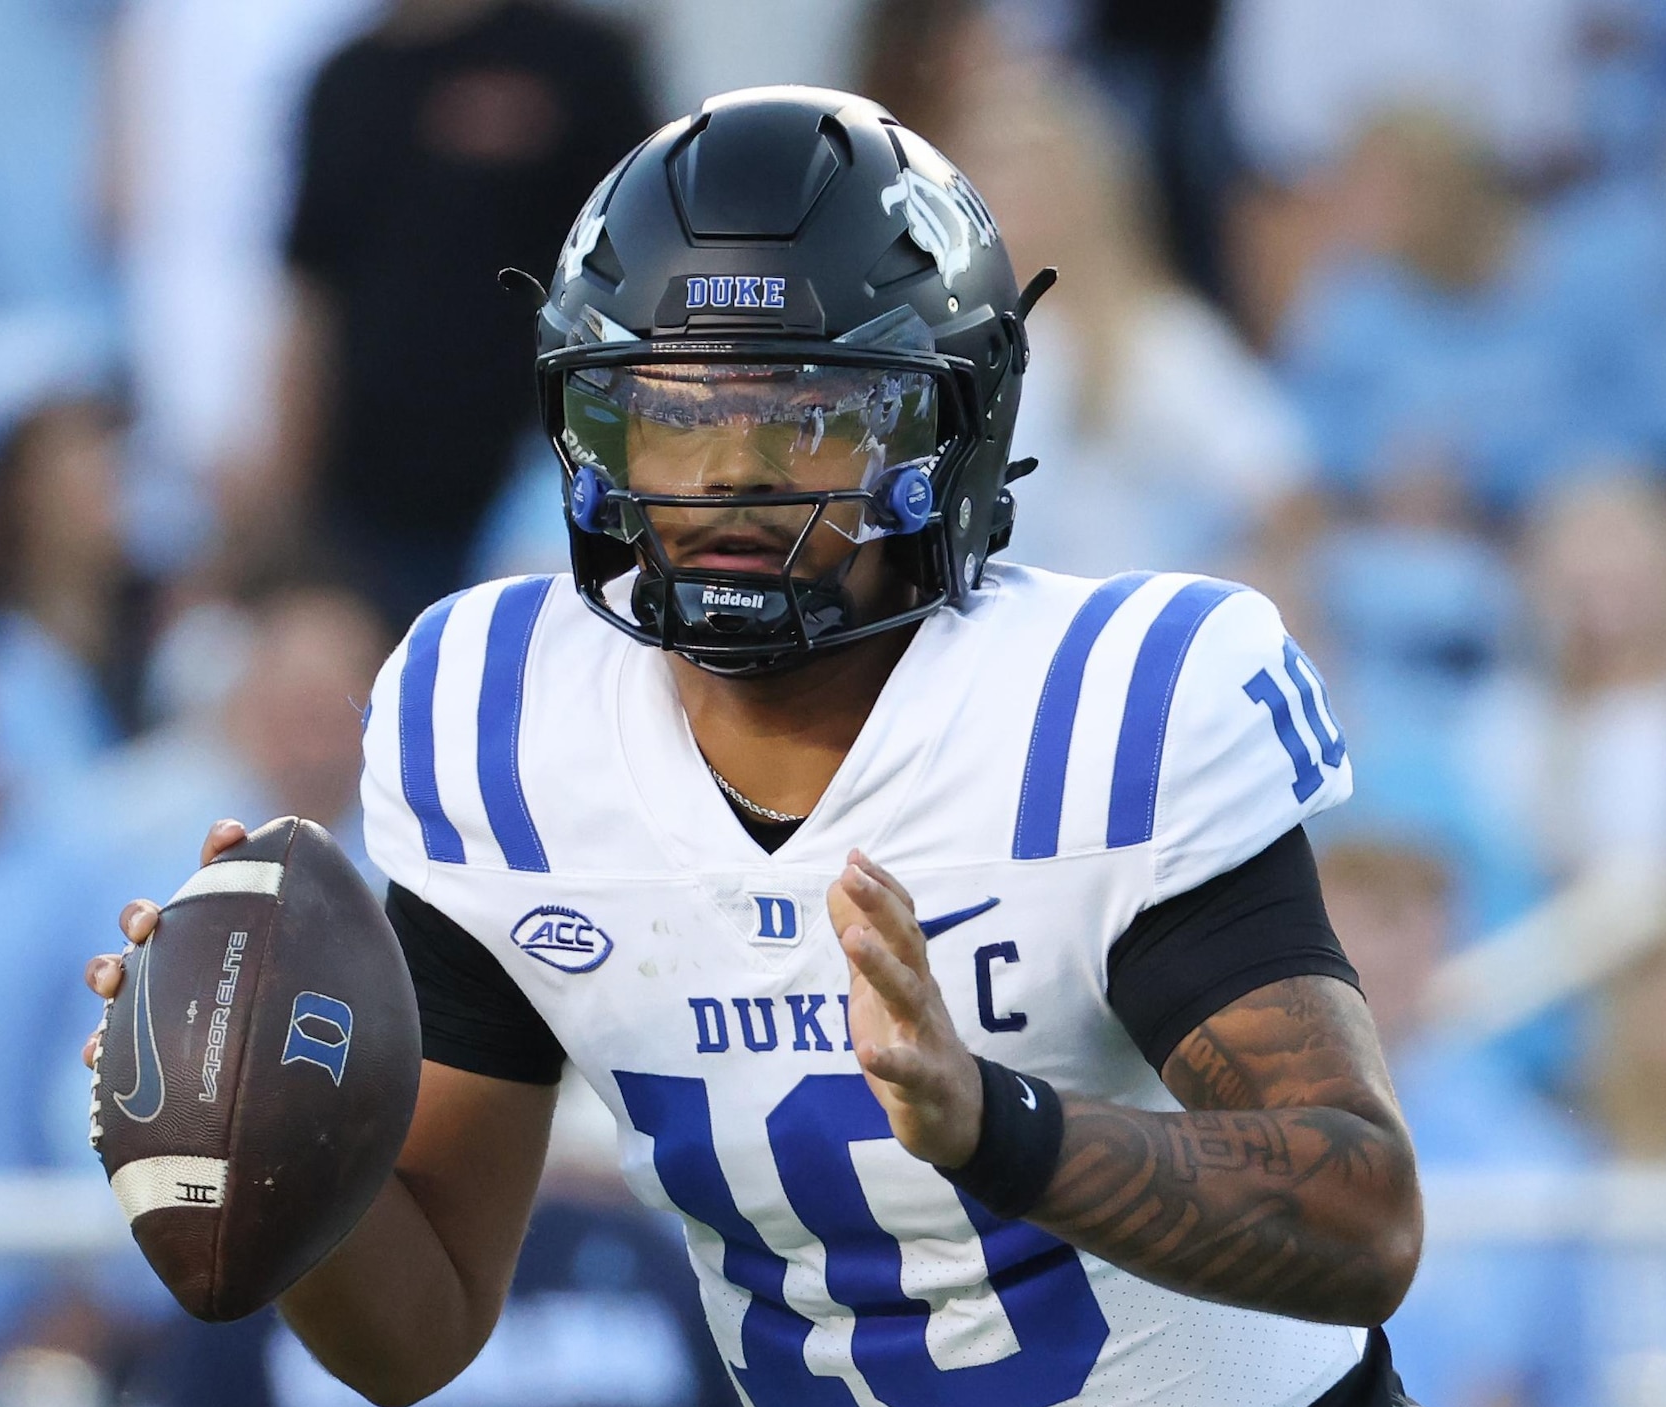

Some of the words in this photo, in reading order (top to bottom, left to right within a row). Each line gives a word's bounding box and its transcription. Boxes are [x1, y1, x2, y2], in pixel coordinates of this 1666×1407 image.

[686, 276, 785, 308] DUKE
[702, 590, 764, 609] Riddell
[1242, 635, 1346, 805] 10
[528, 921, 595, 947] ACC
[752, 895, 799, 942] D
[974, 940, 1027, 1033] C
[199, 1006, 231, 1103] VAPOR
[215, 931, 248, 1007] ELITE
[281, 991, 353, 1088] D
[688, 994, 854, 1054] DUK
